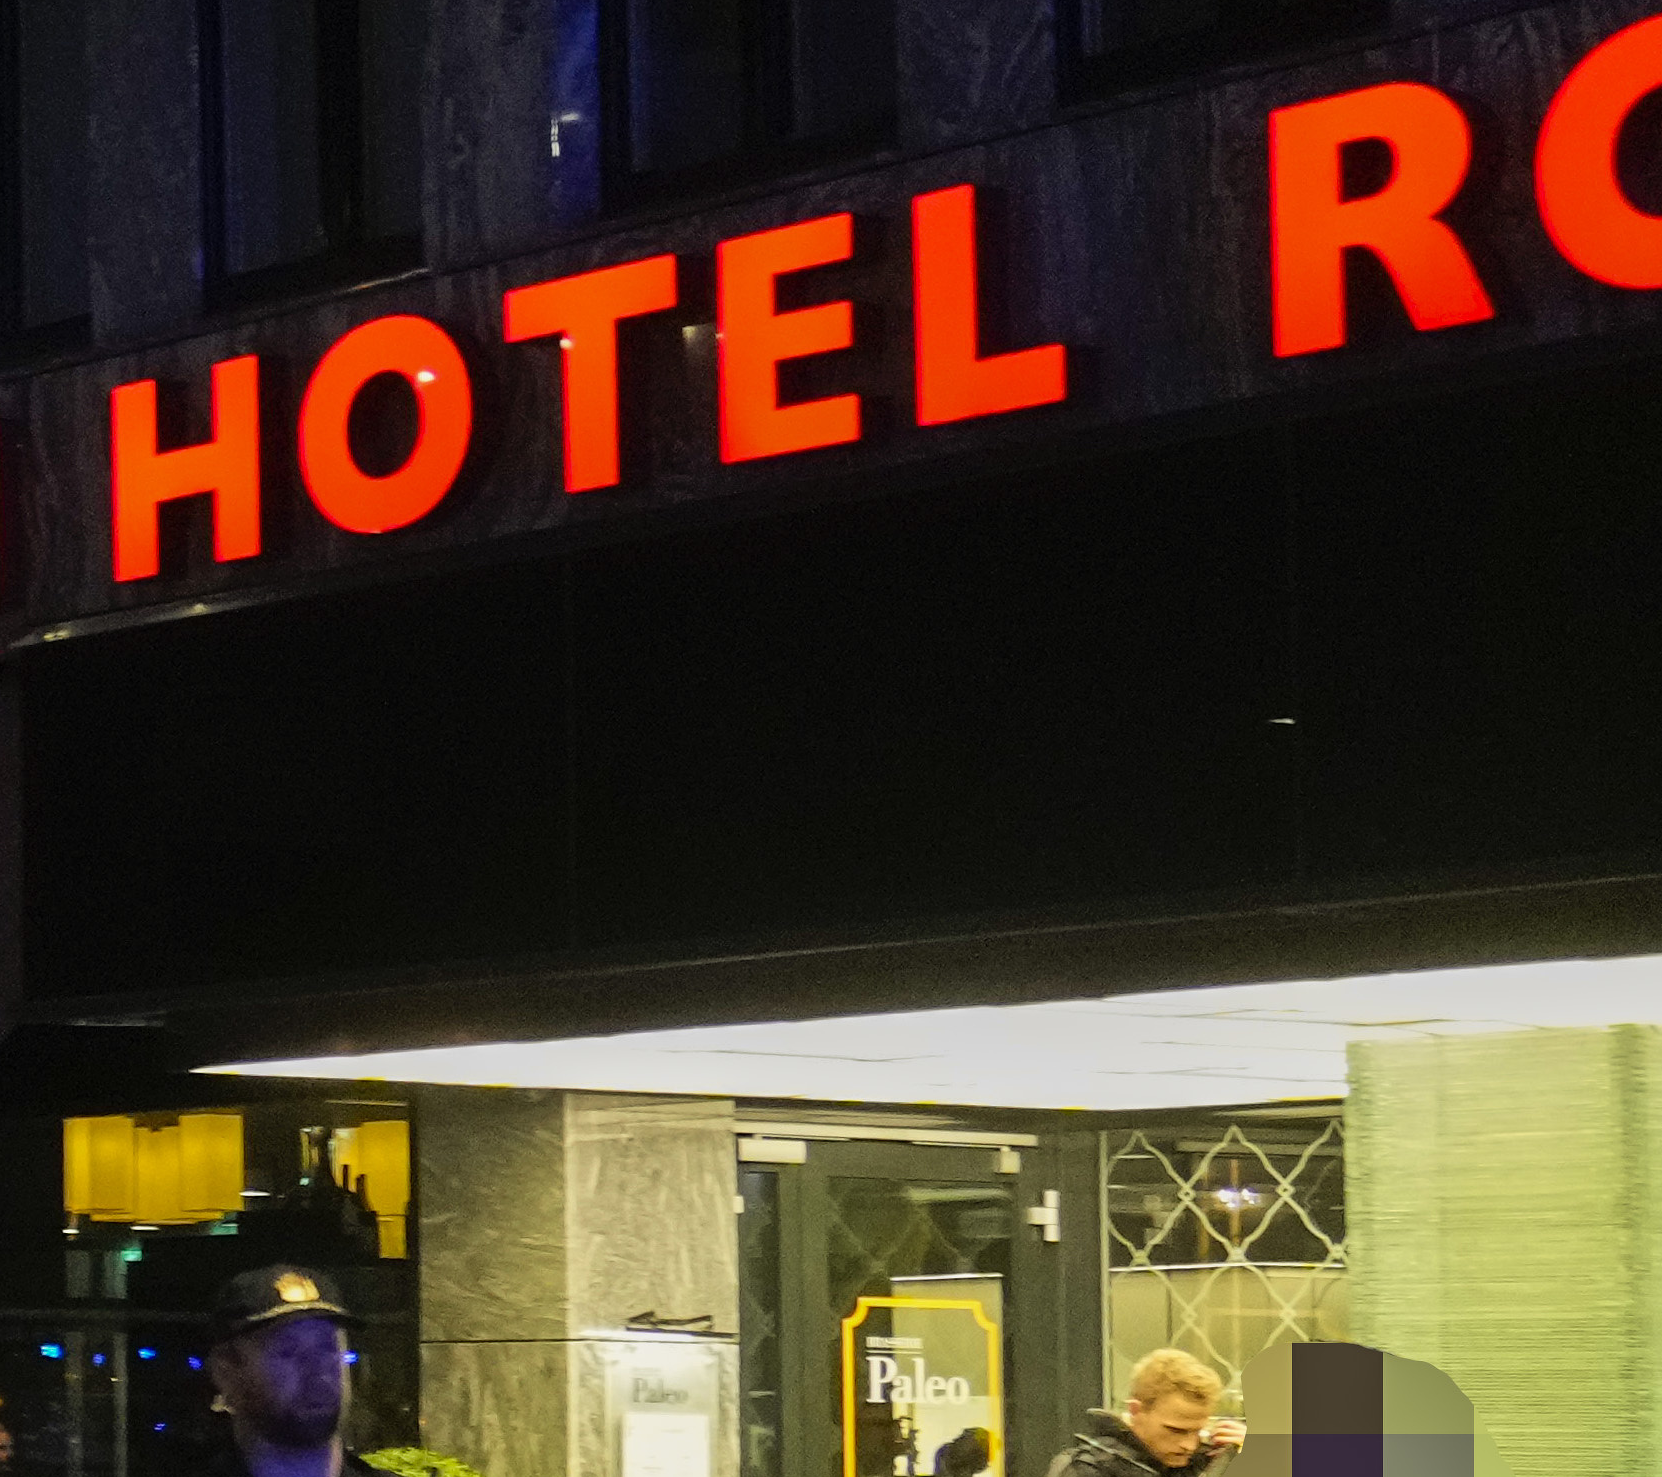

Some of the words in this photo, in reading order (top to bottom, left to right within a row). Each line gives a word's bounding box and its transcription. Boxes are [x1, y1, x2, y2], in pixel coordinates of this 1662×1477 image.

[109, 182, 1068, 583] HOTEL
[1266, 10, 1662, 359] RO
[631, 1376, 690, 1404] Paleo
[865, 1354, 971, 1405] Paleo
